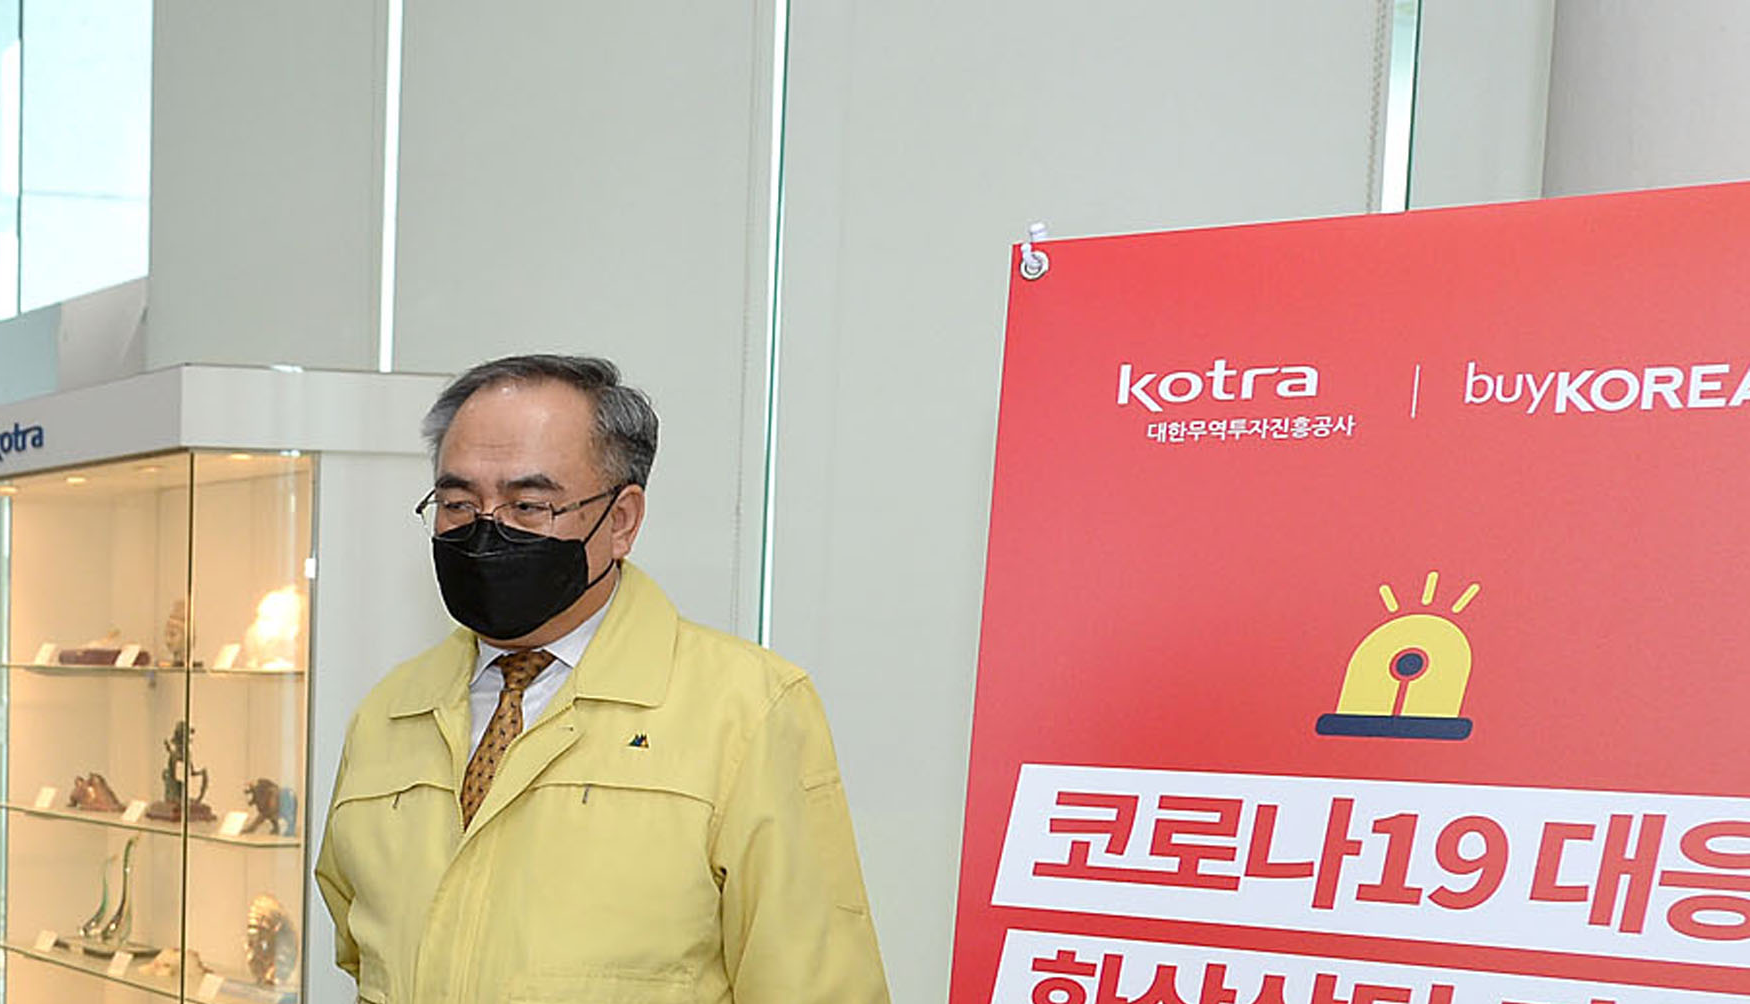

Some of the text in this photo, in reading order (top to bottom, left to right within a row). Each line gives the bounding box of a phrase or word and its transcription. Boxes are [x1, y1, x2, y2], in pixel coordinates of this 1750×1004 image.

[1118, 360, 1317, 411] kotra
[1148, 415, 1355, 442] 대한무역투자진흥공사
[1033, 792, 1509, 910] 코로나19
